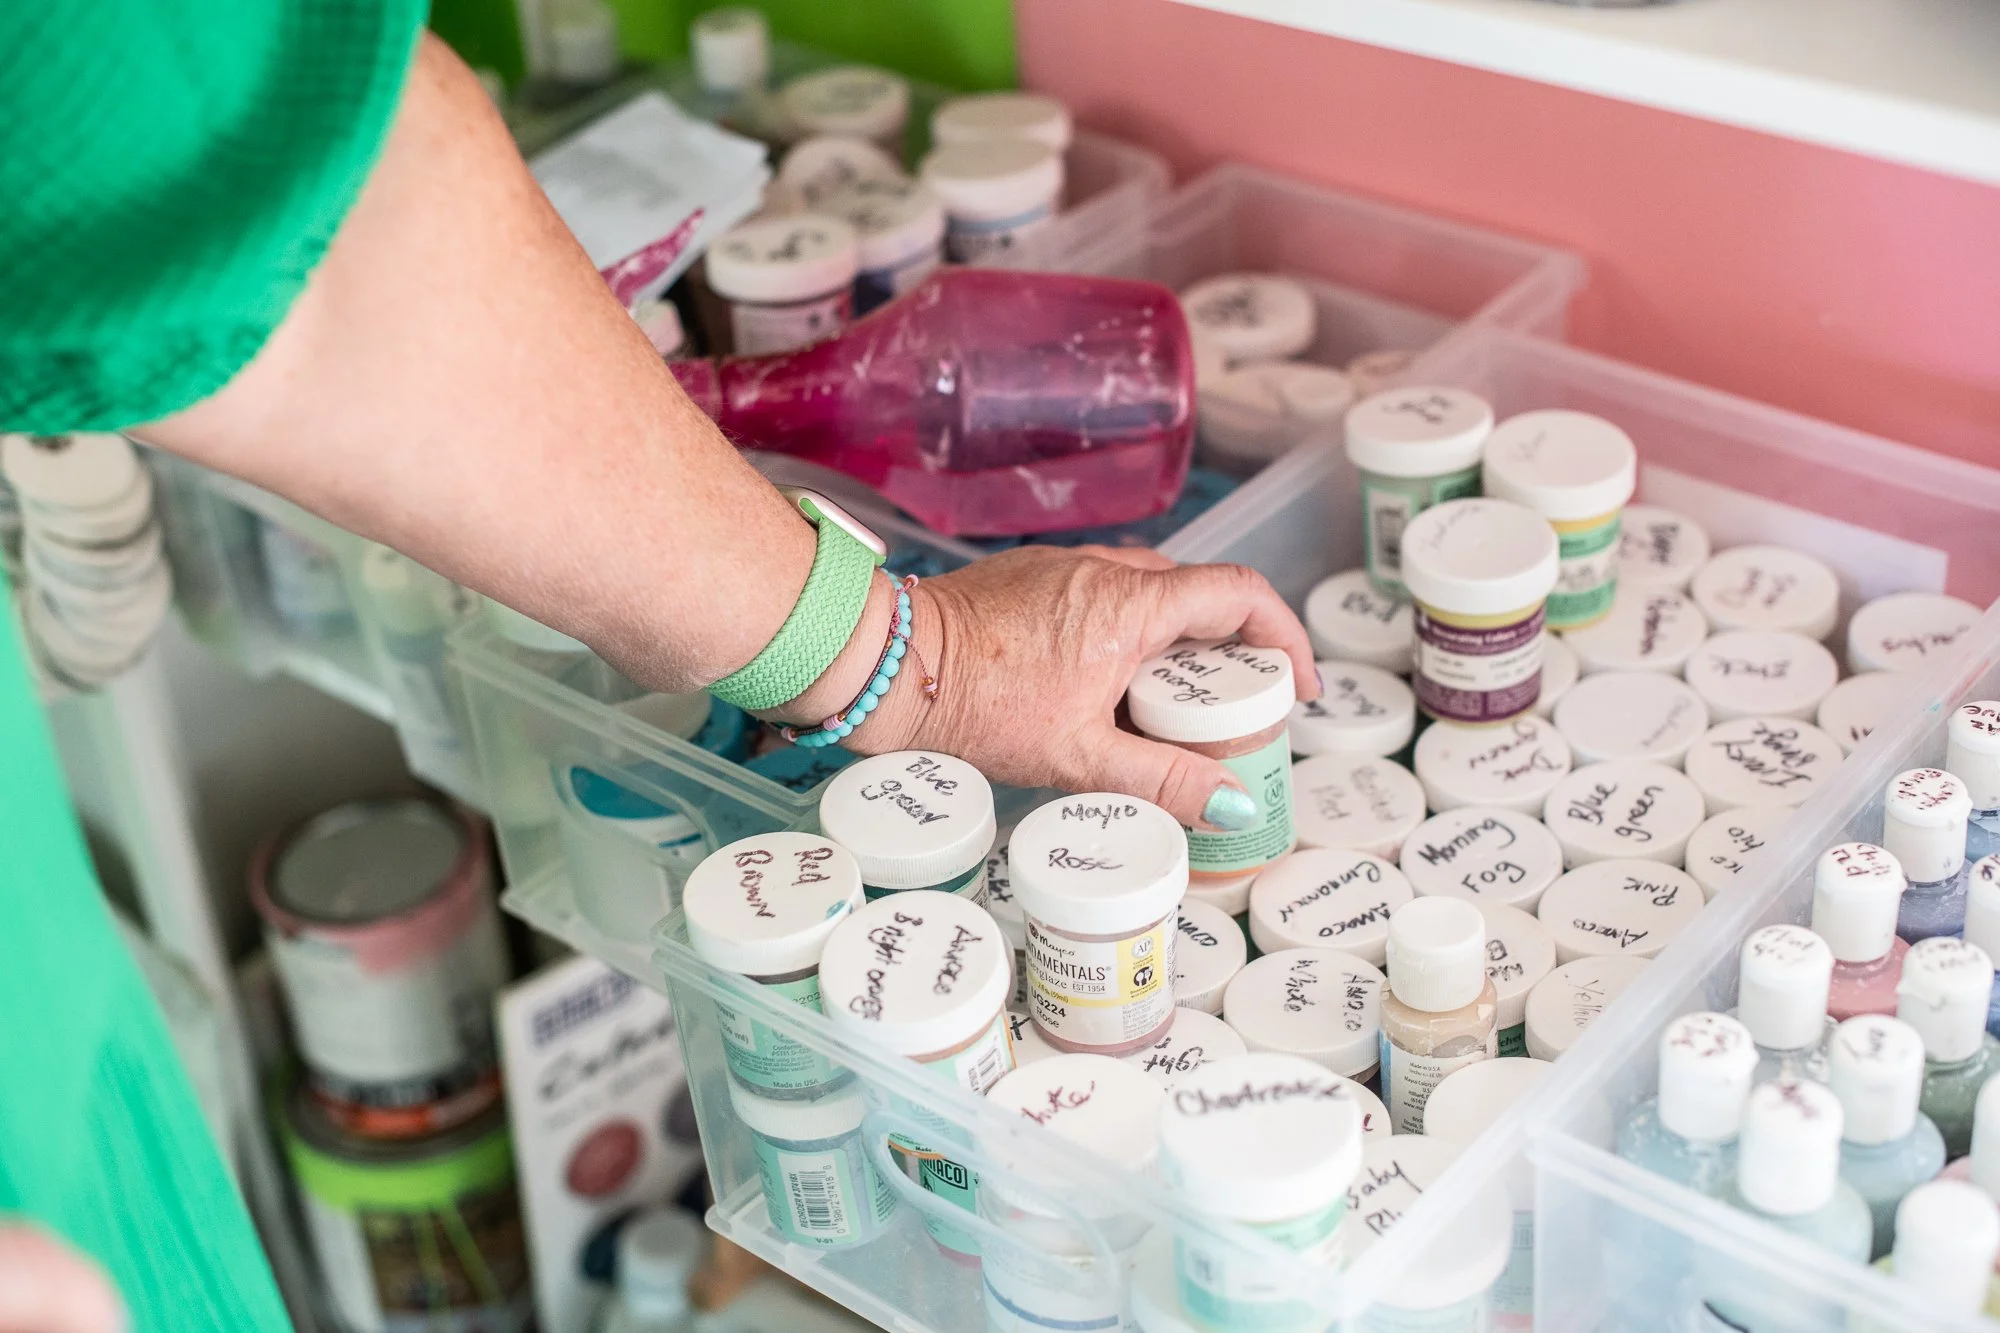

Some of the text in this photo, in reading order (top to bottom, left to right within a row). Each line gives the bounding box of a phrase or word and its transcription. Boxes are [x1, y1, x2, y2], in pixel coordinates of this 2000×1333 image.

[1048, 848, 1123, 870] Rose
[1461, 860, 1526, 894] Fog
[1072, 983, 1084, 991] EST
